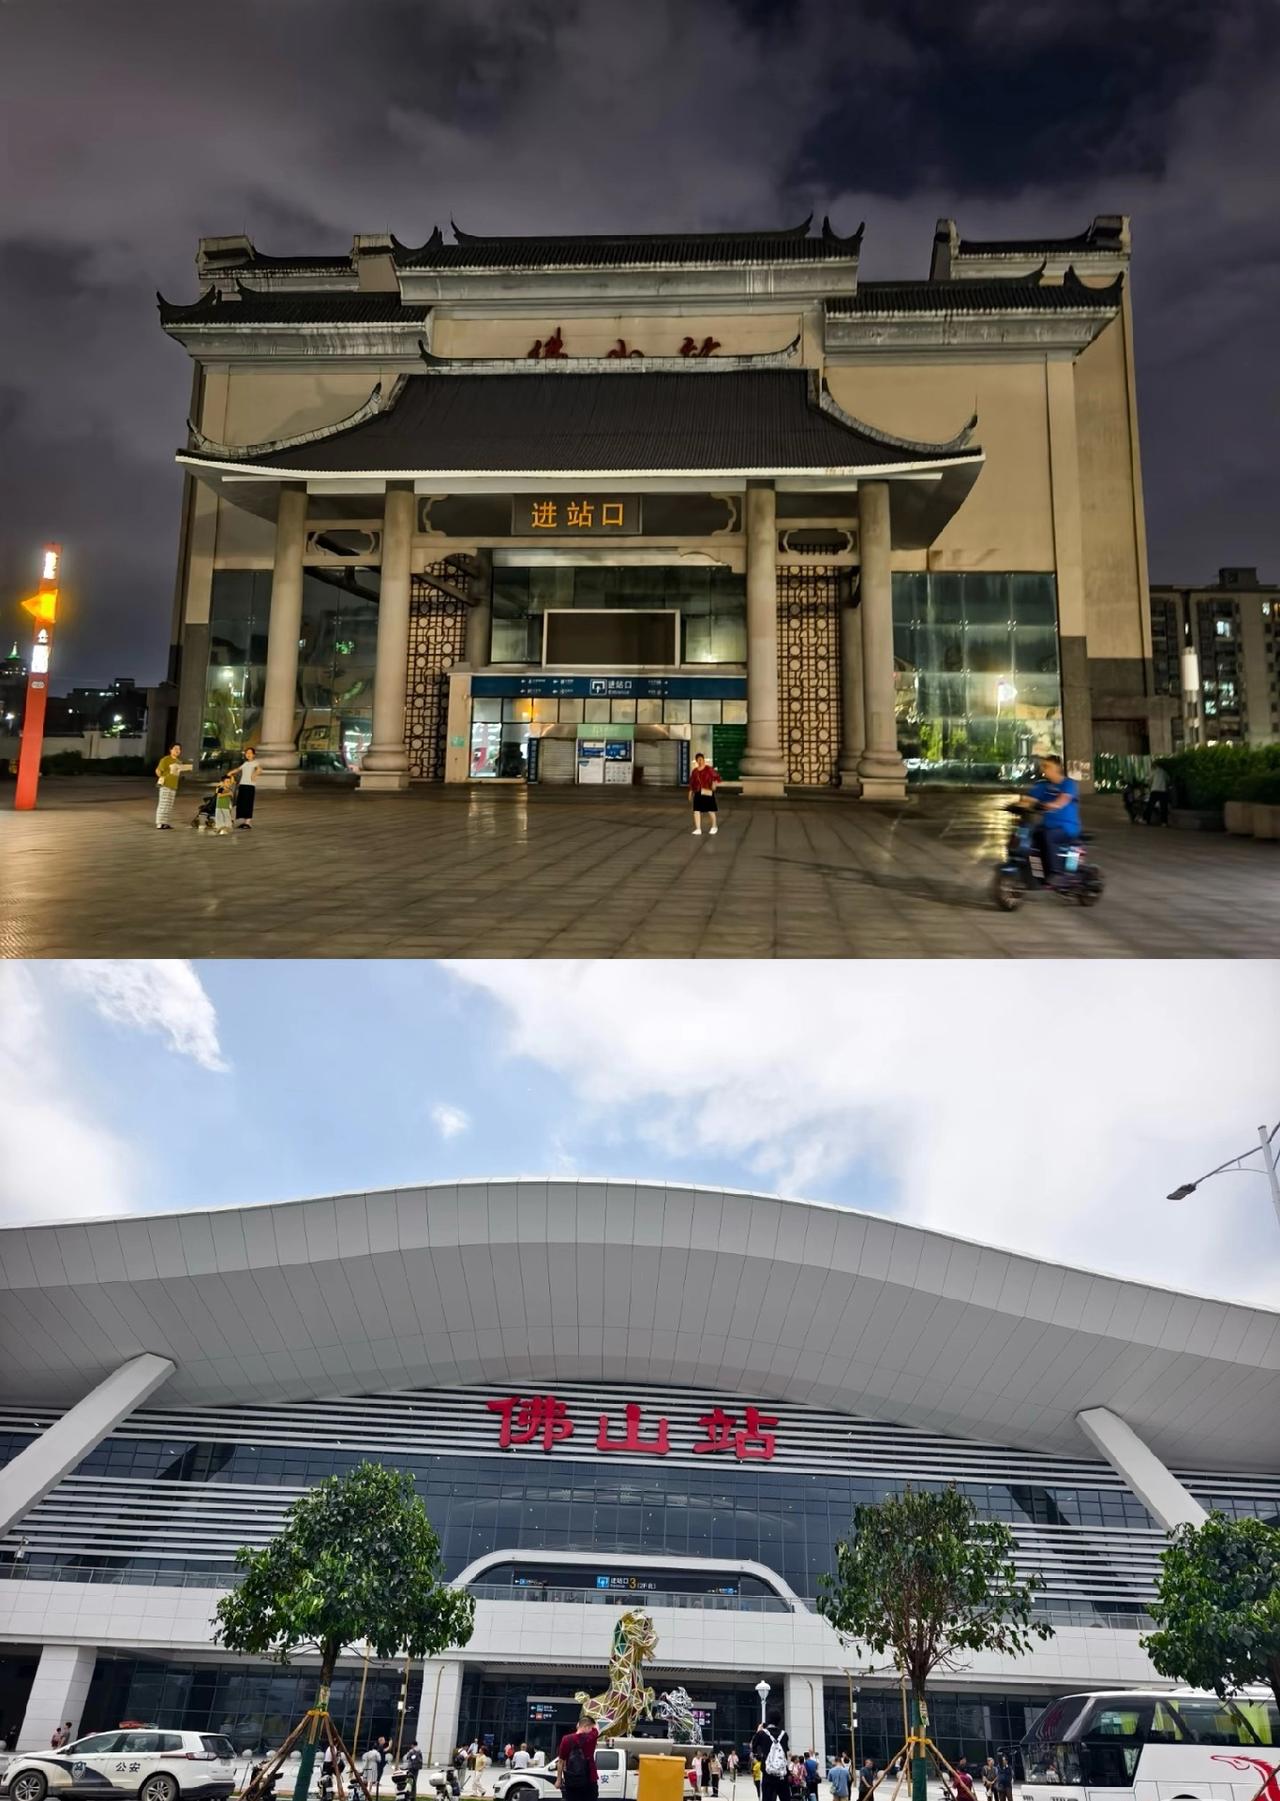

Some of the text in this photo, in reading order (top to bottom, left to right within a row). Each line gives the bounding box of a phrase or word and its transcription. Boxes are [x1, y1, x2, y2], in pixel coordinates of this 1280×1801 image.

[531, 501, 623, 528] 进站口
[608, 680, 632, 689] 进站口
[486, 1396, 779, 1460] 佛山站
[629, 1577, 637, 1589] 3
[115, 1761, 141, 1773] 公安
[600, 1774, 609, 1784] 安
